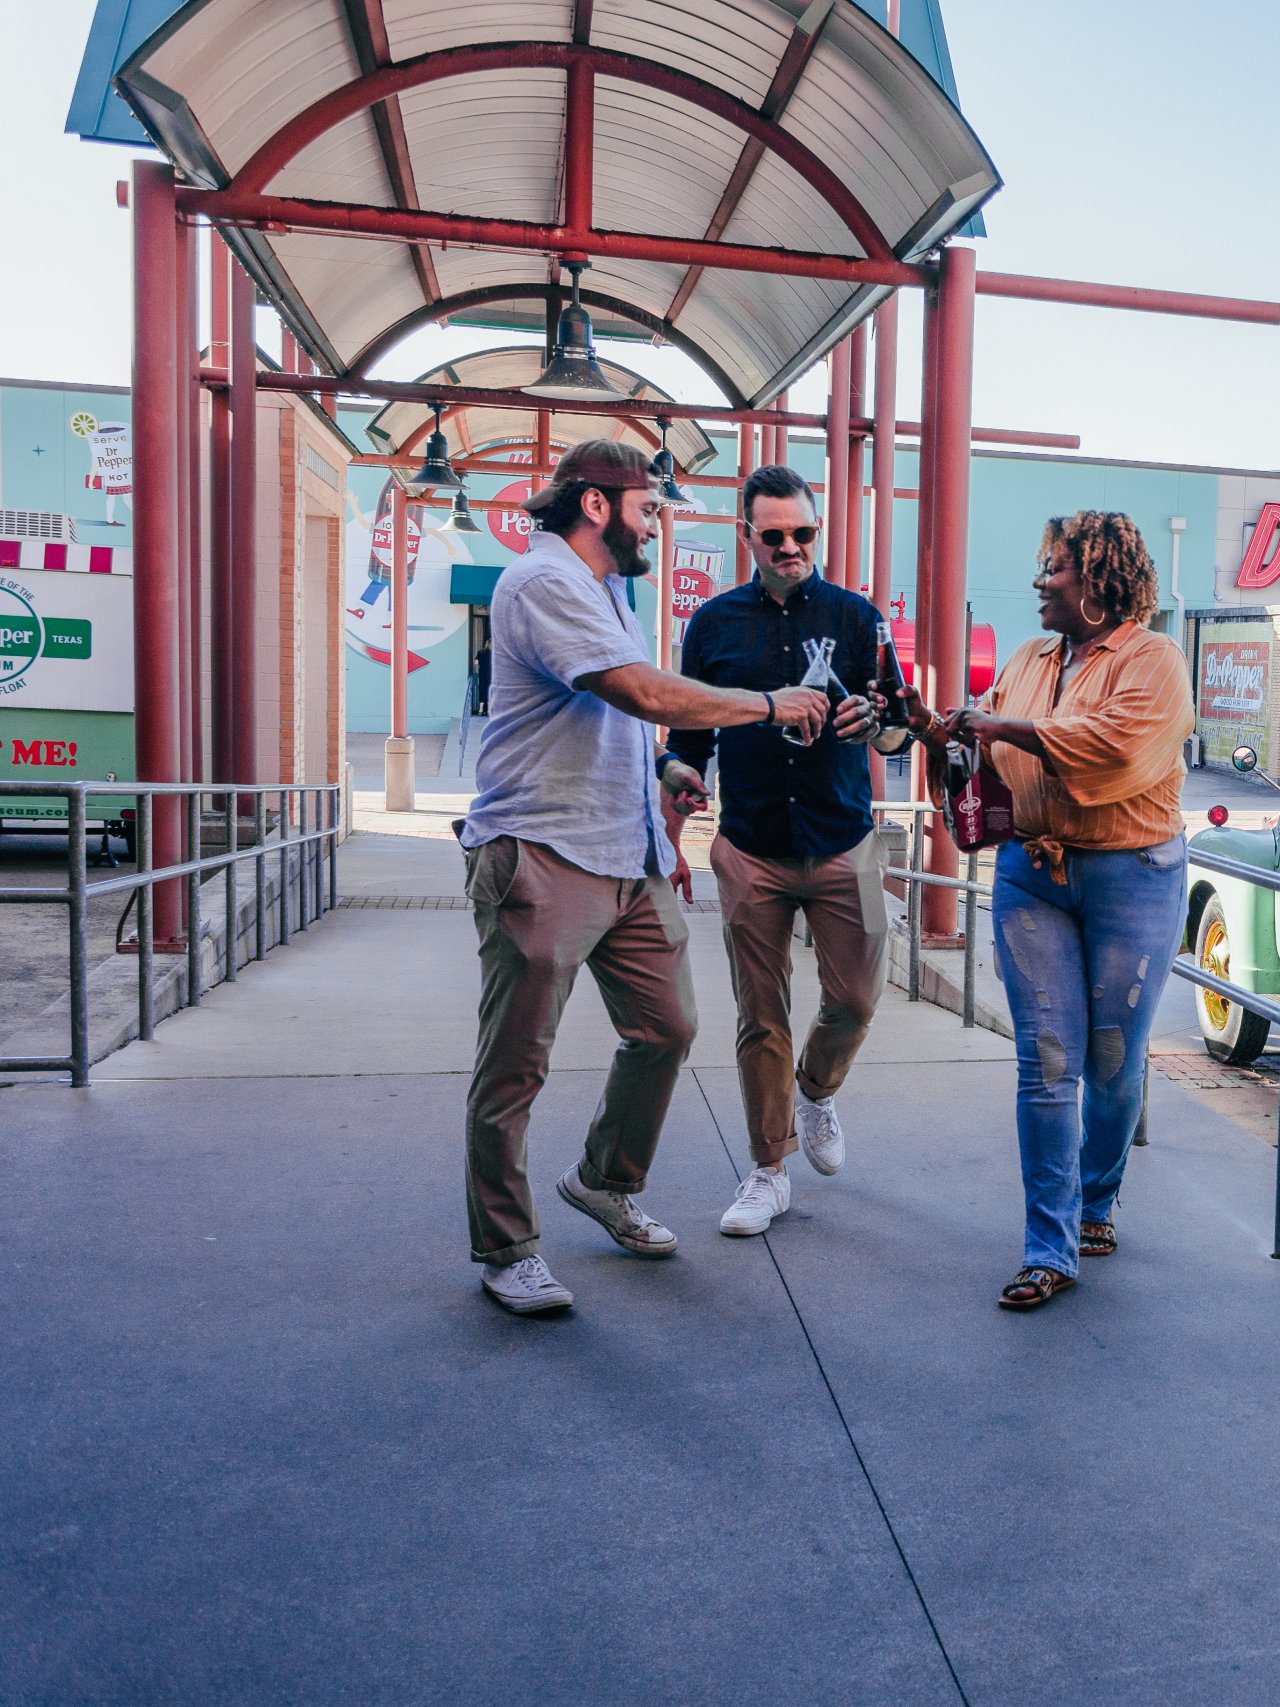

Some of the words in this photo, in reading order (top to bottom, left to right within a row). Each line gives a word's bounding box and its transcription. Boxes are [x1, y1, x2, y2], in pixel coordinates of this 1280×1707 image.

[94, 435, 127, 444] serve
[105, 448, 118, 457] Dr
[109, 473, 128, 481] HOT
[680, 575, 699, 591] Dr
[7, 580, 20, 590] OF
[19, 586, 36, 602] THE
[52, 635, 83, 645] TEXAS
[1240, 649, 1259, 660] DRINK
[1221, 652, 1264, 698] Pepper
[12, 740, 77, 767] ME!
